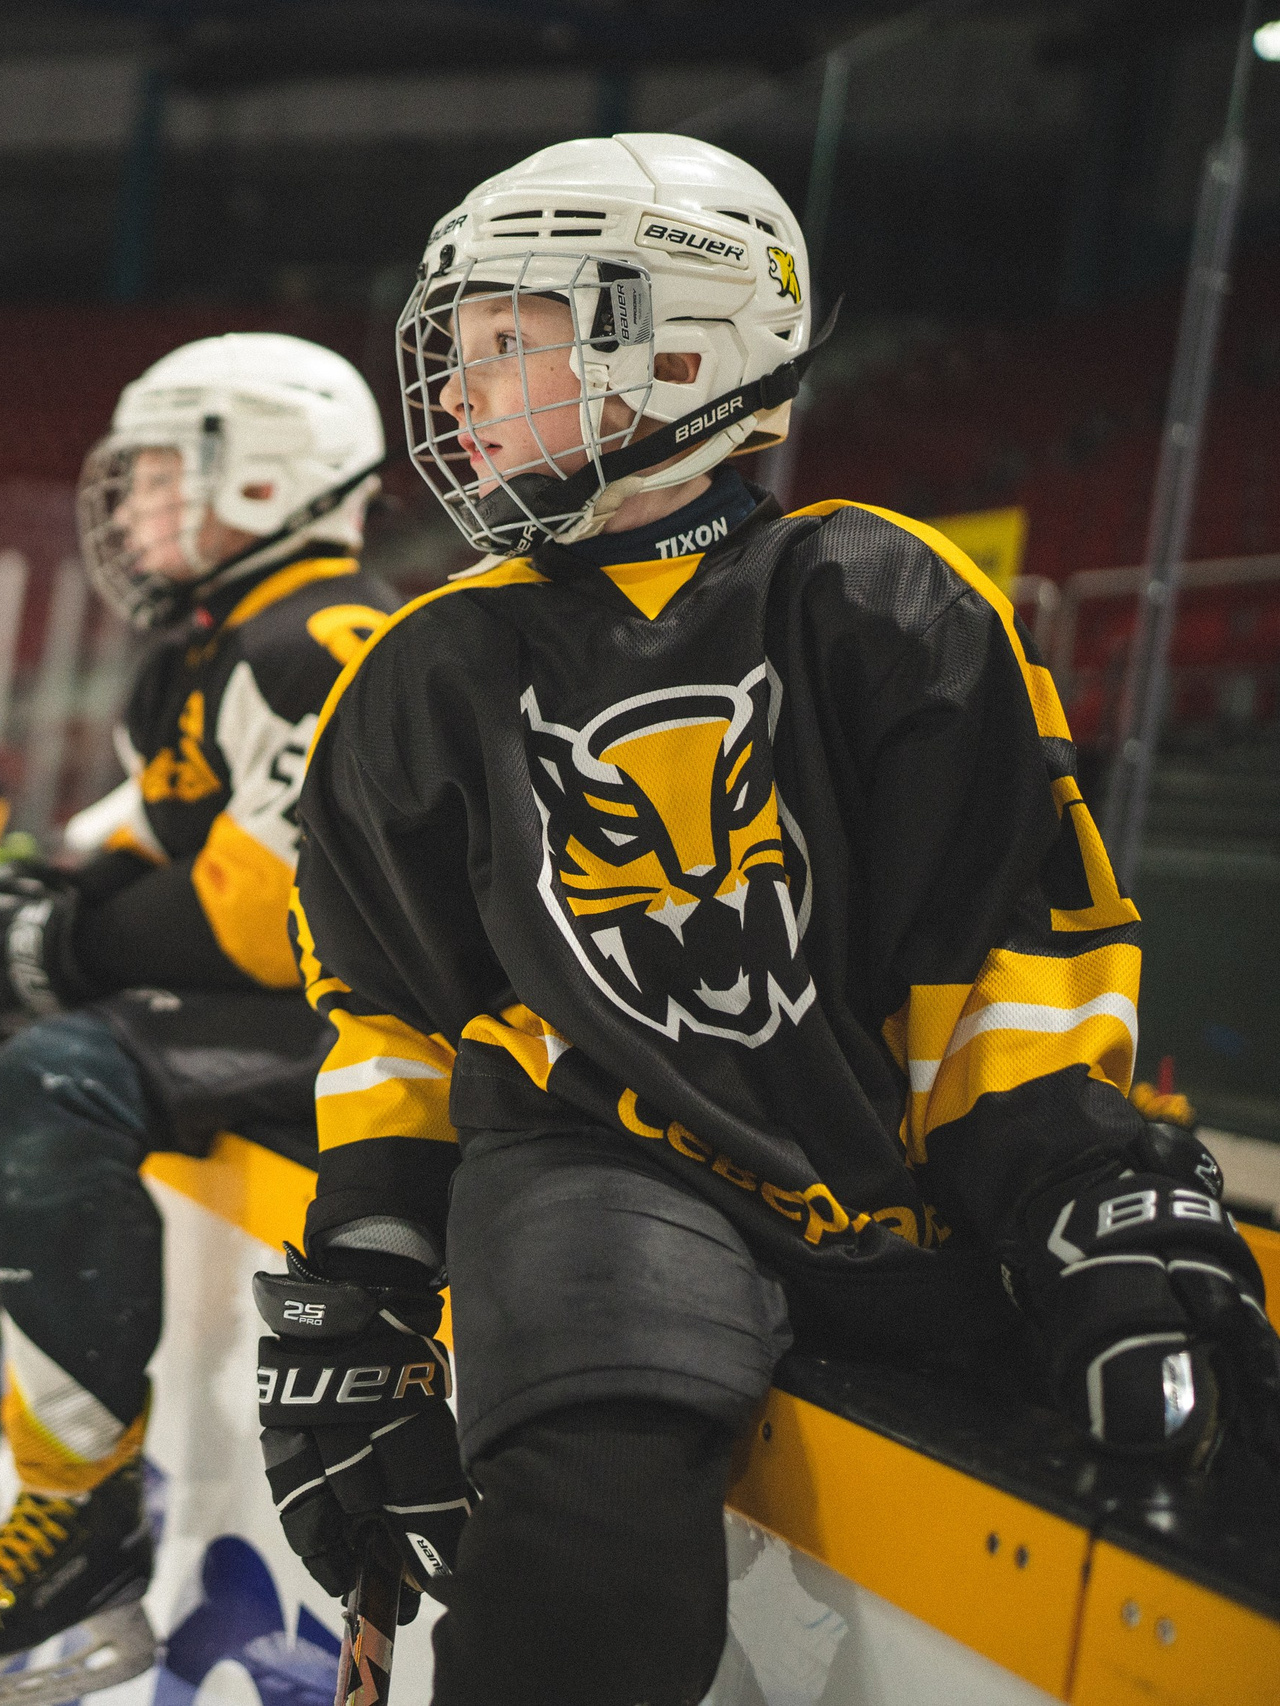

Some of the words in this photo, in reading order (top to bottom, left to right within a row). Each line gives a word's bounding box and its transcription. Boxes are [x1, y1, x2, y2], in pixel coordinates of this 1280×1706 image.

[655, 516, 729, 560] TIXON
[283, 1300, 327, 1320] 25
[298, 1317, 323, 1326] PRO
[257, 1362, 436, 1406] AUER
